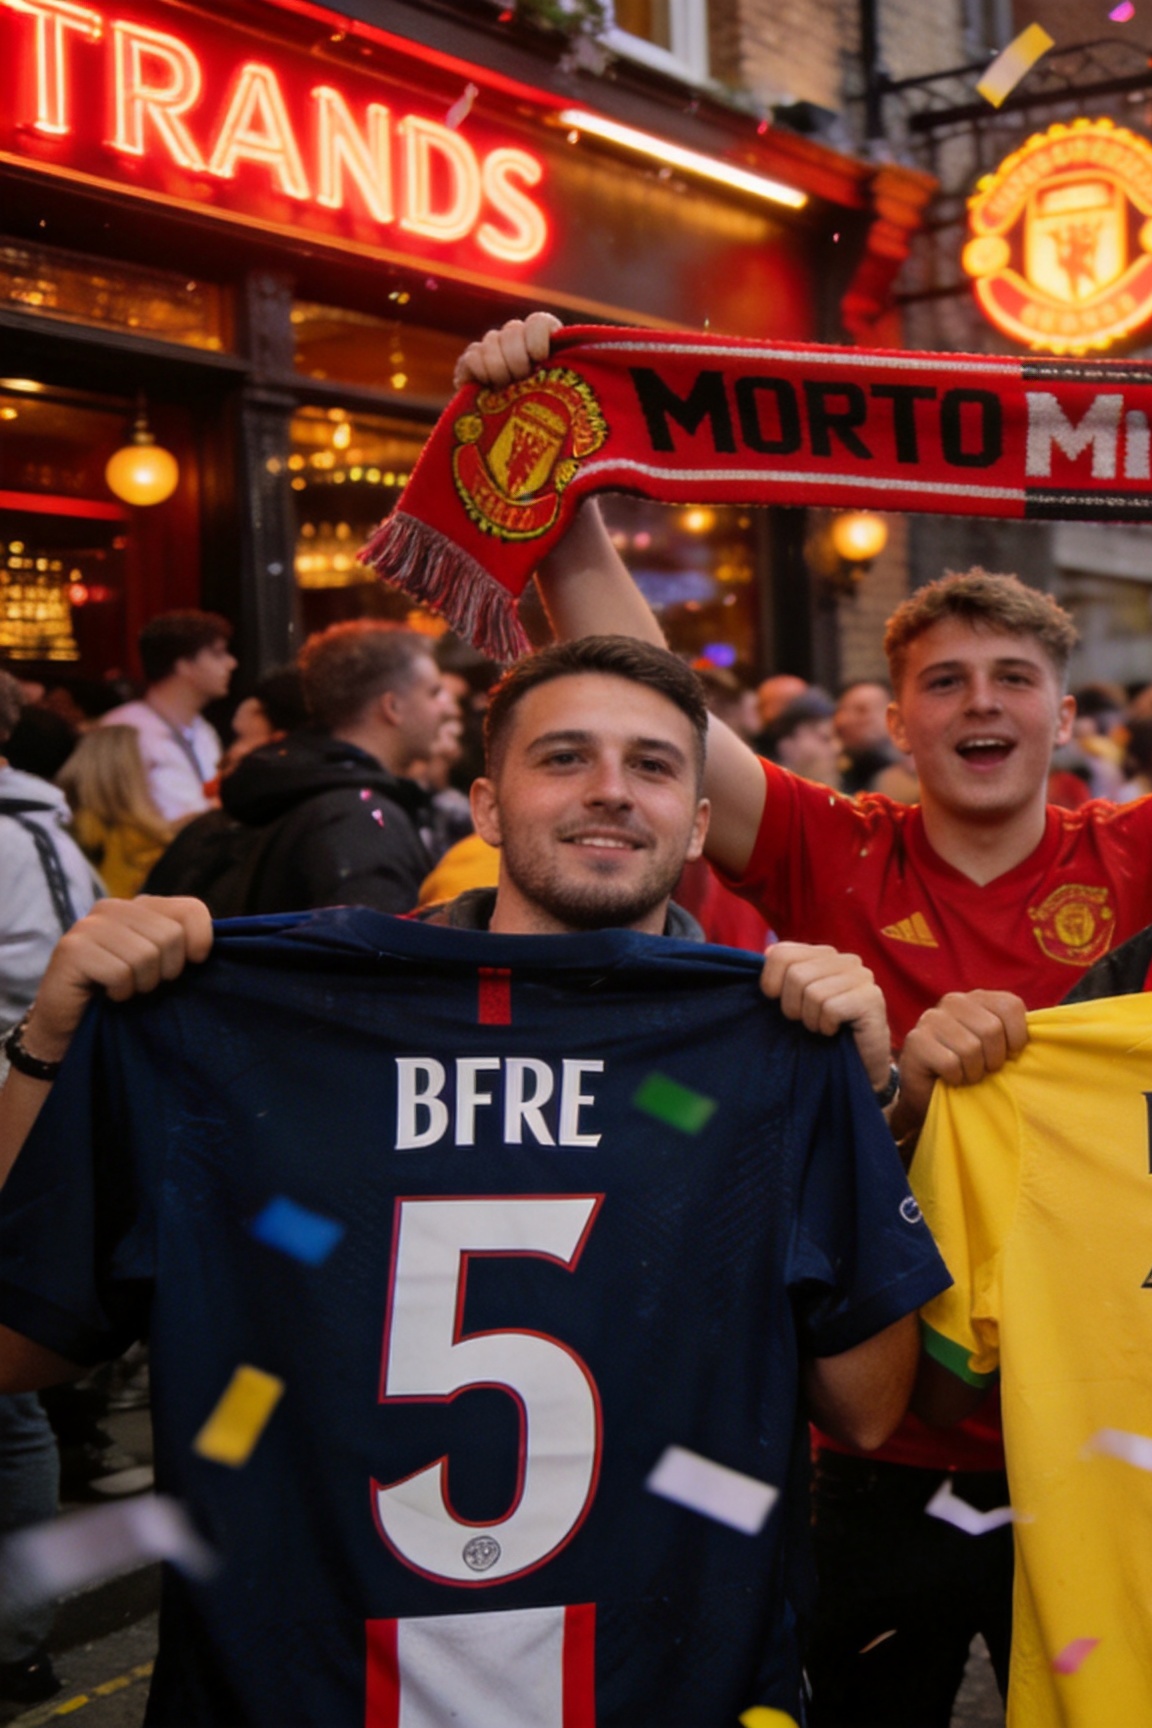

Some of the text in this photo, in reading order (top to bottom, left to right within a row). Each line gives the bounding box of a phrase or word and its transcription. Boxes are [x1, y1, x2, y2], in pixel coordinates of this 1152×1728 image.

[0, 0, 549, 263] TRANDS
[628, 367, 1003, 468] MORTO
[394, 1057, 604, 1150] BFRE
[369, 1193, 606, 1587] 5
